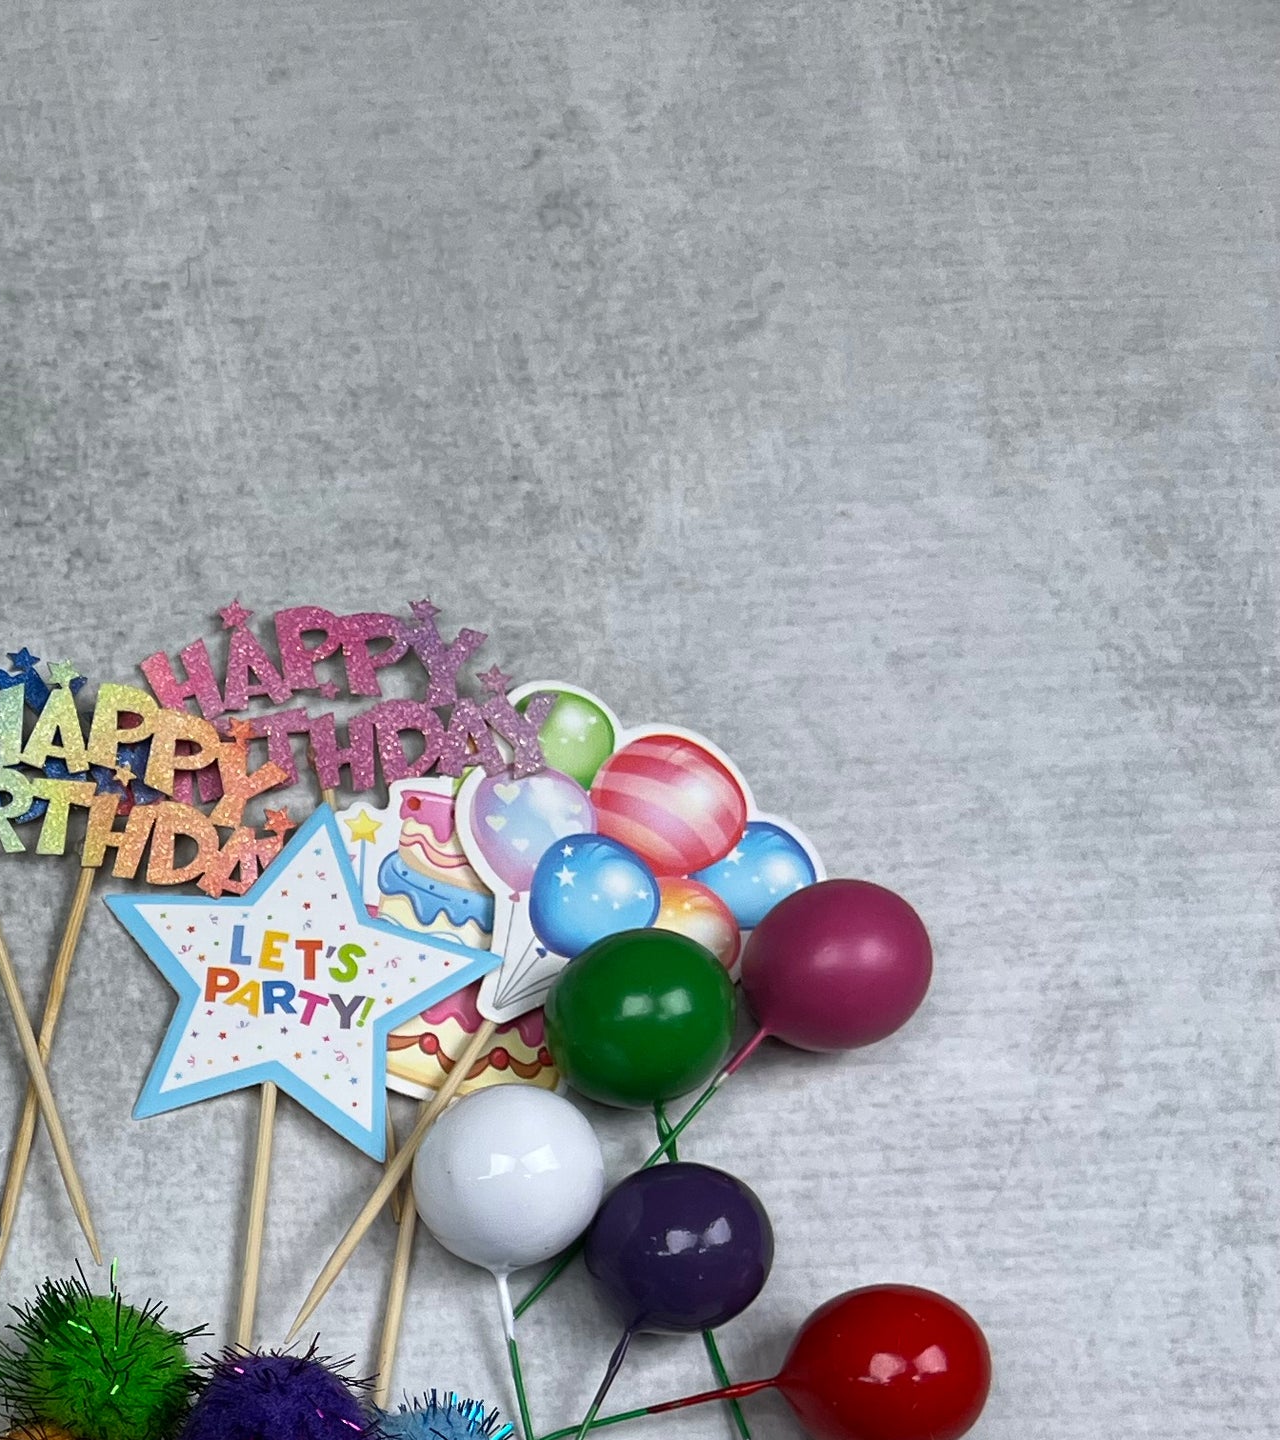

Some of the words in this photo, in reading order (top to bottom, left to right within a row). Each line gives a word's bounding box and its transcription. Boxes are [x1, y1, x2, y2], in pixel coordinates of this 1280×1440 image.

[140, 605, 488, 708] HAPPY
[230, 924, 366, 983] LET'S
[203, 966, 375, 1029] PARTY!
